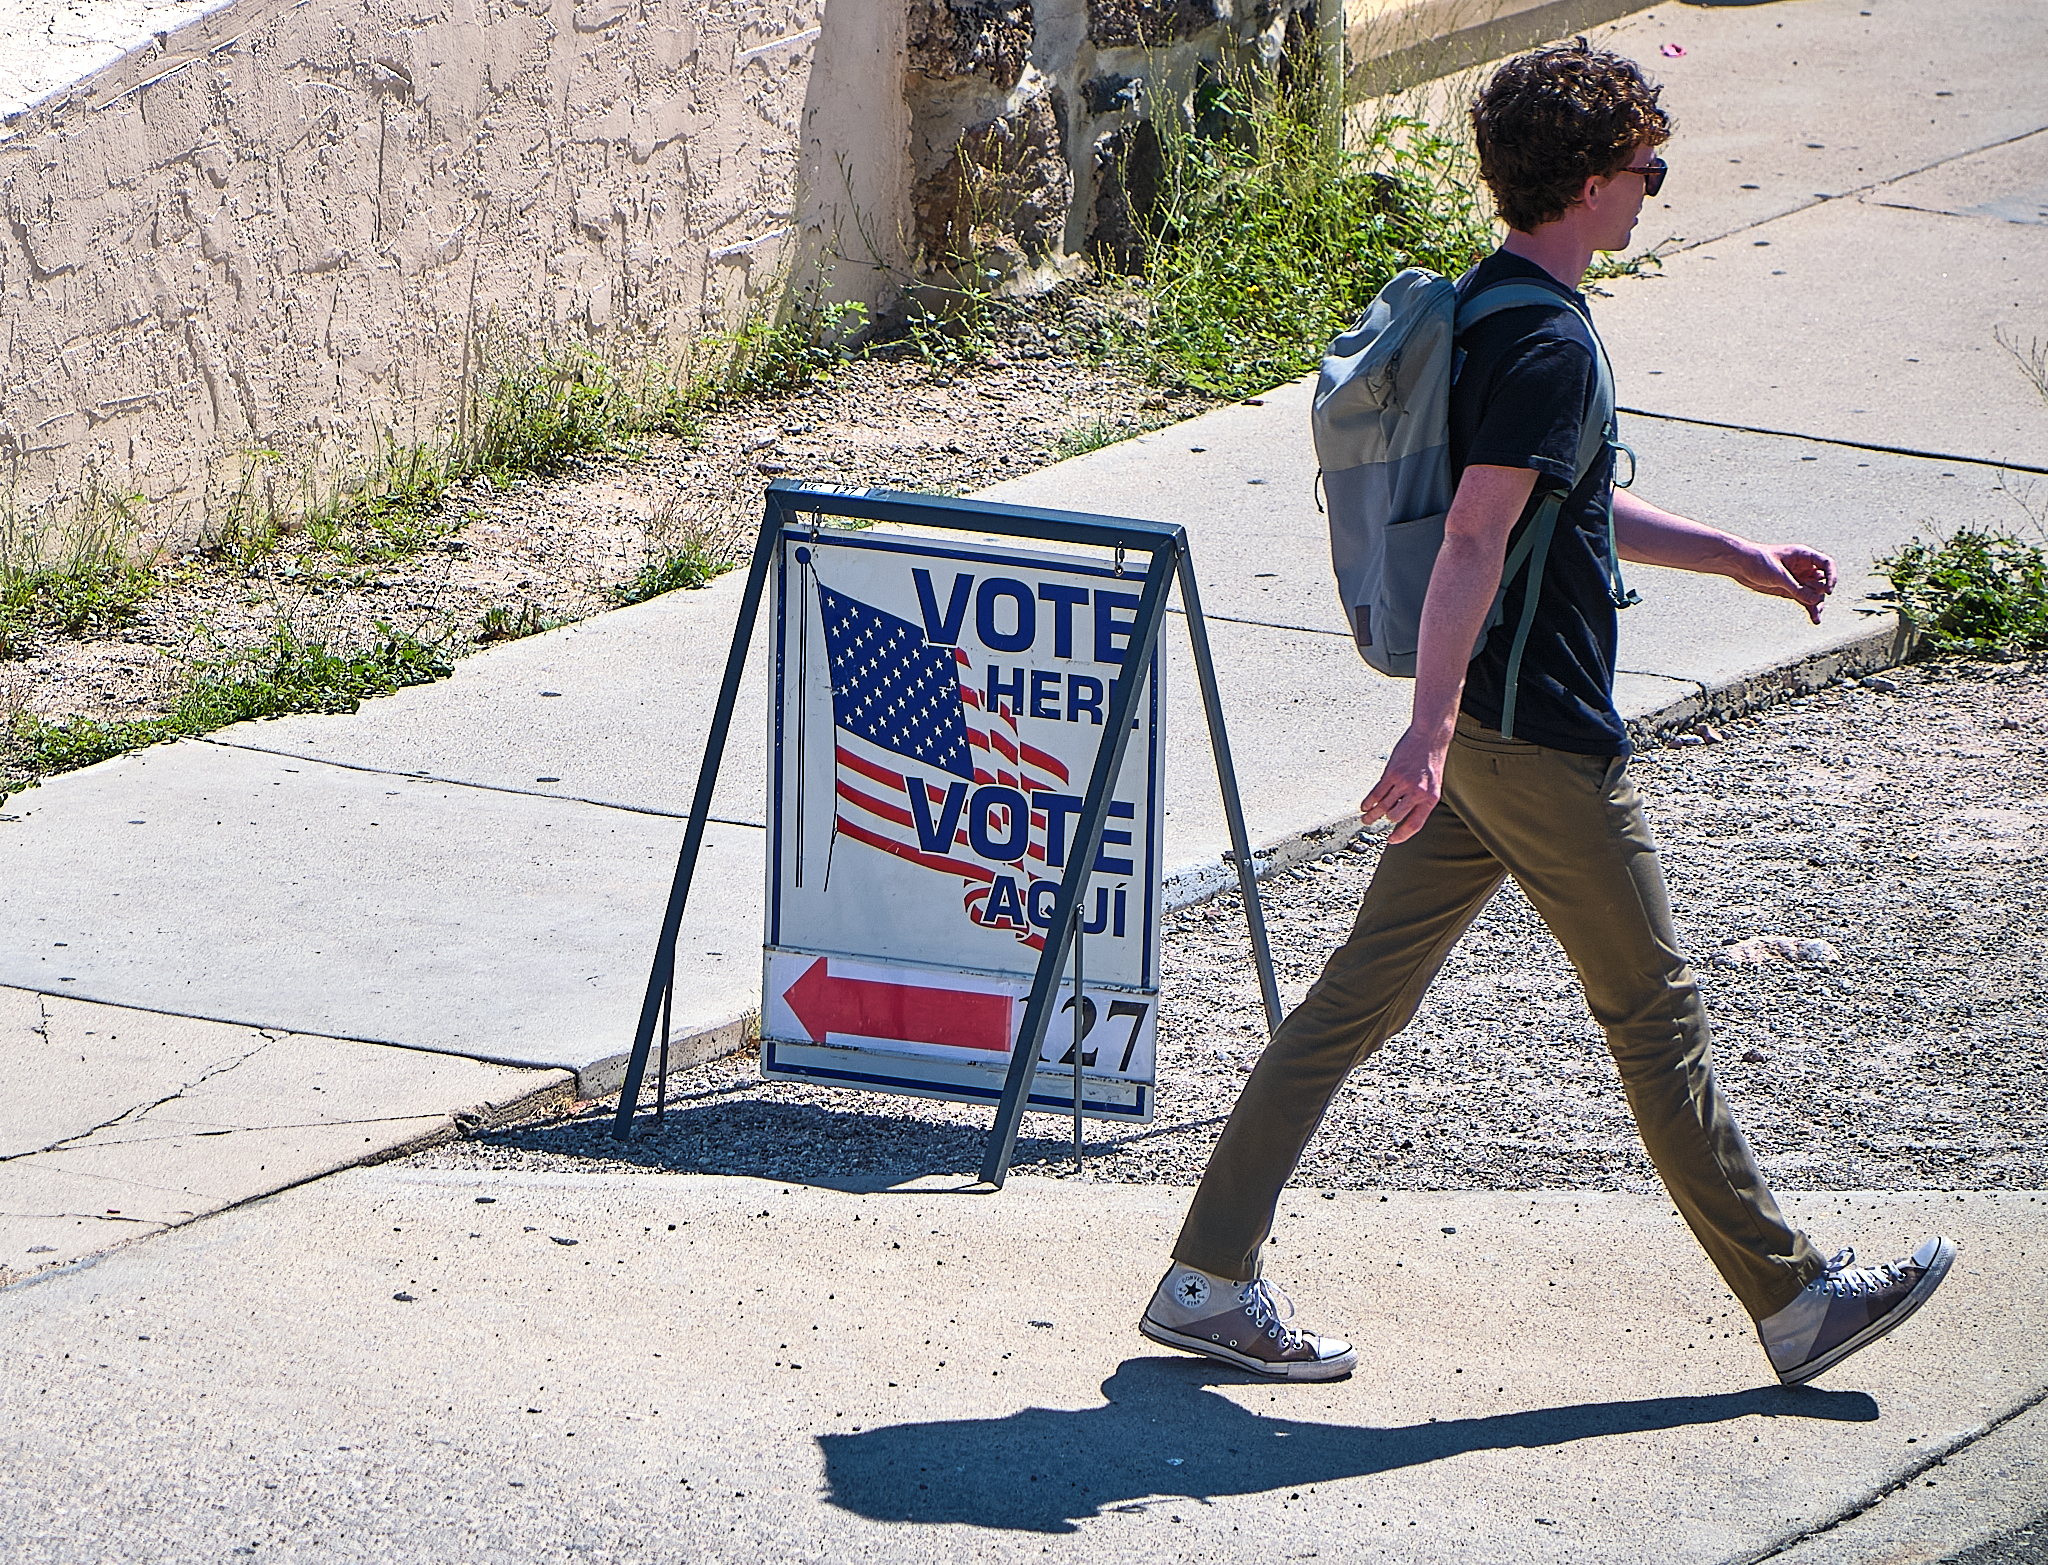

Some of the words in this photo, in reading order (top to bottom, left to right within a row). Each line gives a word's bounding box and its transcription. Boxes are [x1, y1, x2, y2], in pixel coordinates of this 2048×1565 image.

[911, 567, 1140, 666] VOTE
[905, 776, 1135, 877] VOTE
[1018, 995, 1150, 1072] 27
